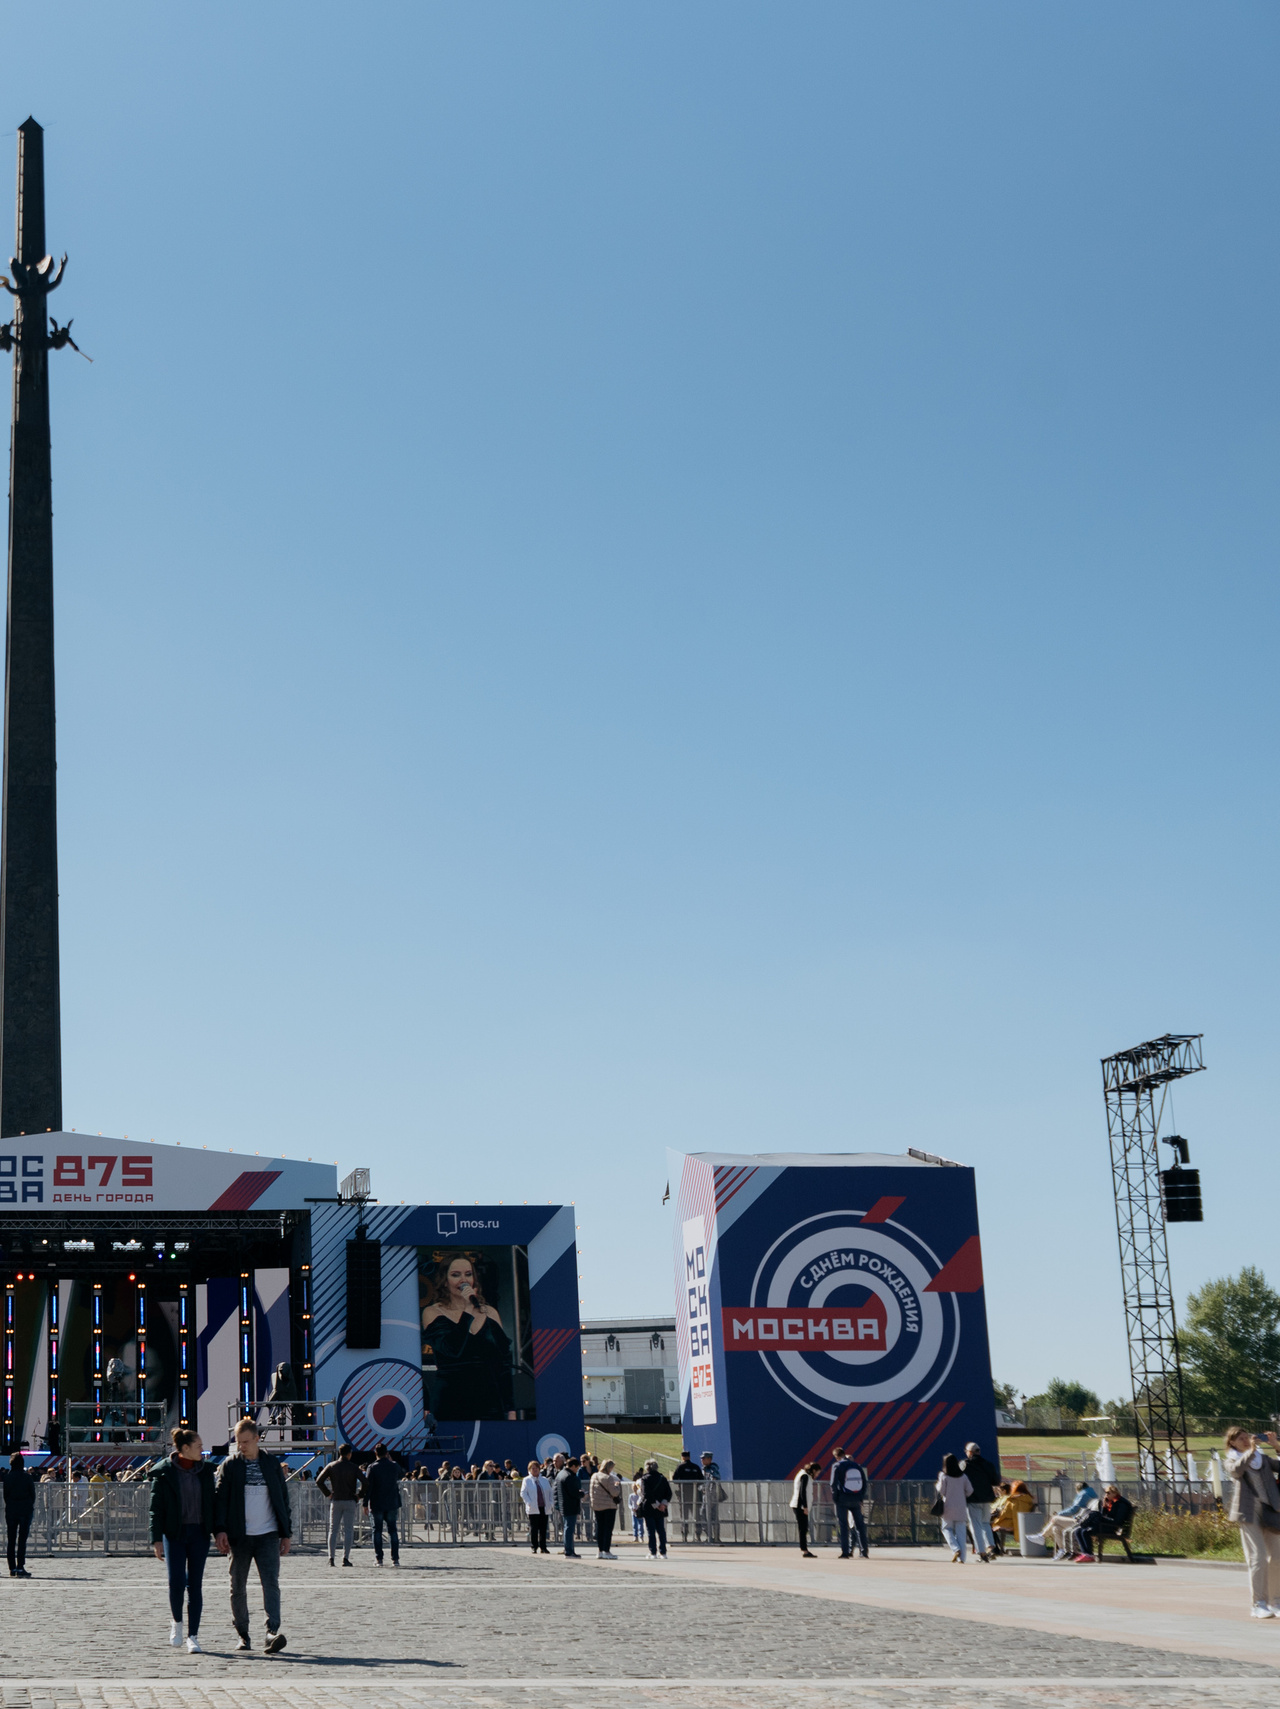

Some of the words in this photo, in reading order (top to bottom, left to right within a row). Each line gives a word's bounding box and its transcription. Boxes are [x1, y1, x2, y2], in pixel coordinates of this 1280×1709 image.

[53, 1155, 153, 1187] 875
[53, 1193, 91, 1203] ДЕНЬ
[96, 1193, 154, 1203] ГОРОДА
[460, 1220, 499, 1229] mos.ru
[800, 1276, 813, 1289] С
[810, 1251, 855, 1281] ДНЁМ
[858, 1254, 919, 1333] РОЖДЕНИЯ
[732, 1318, 879, 1340] МОСКВА
[693, 1364, 712, 1388] 875
